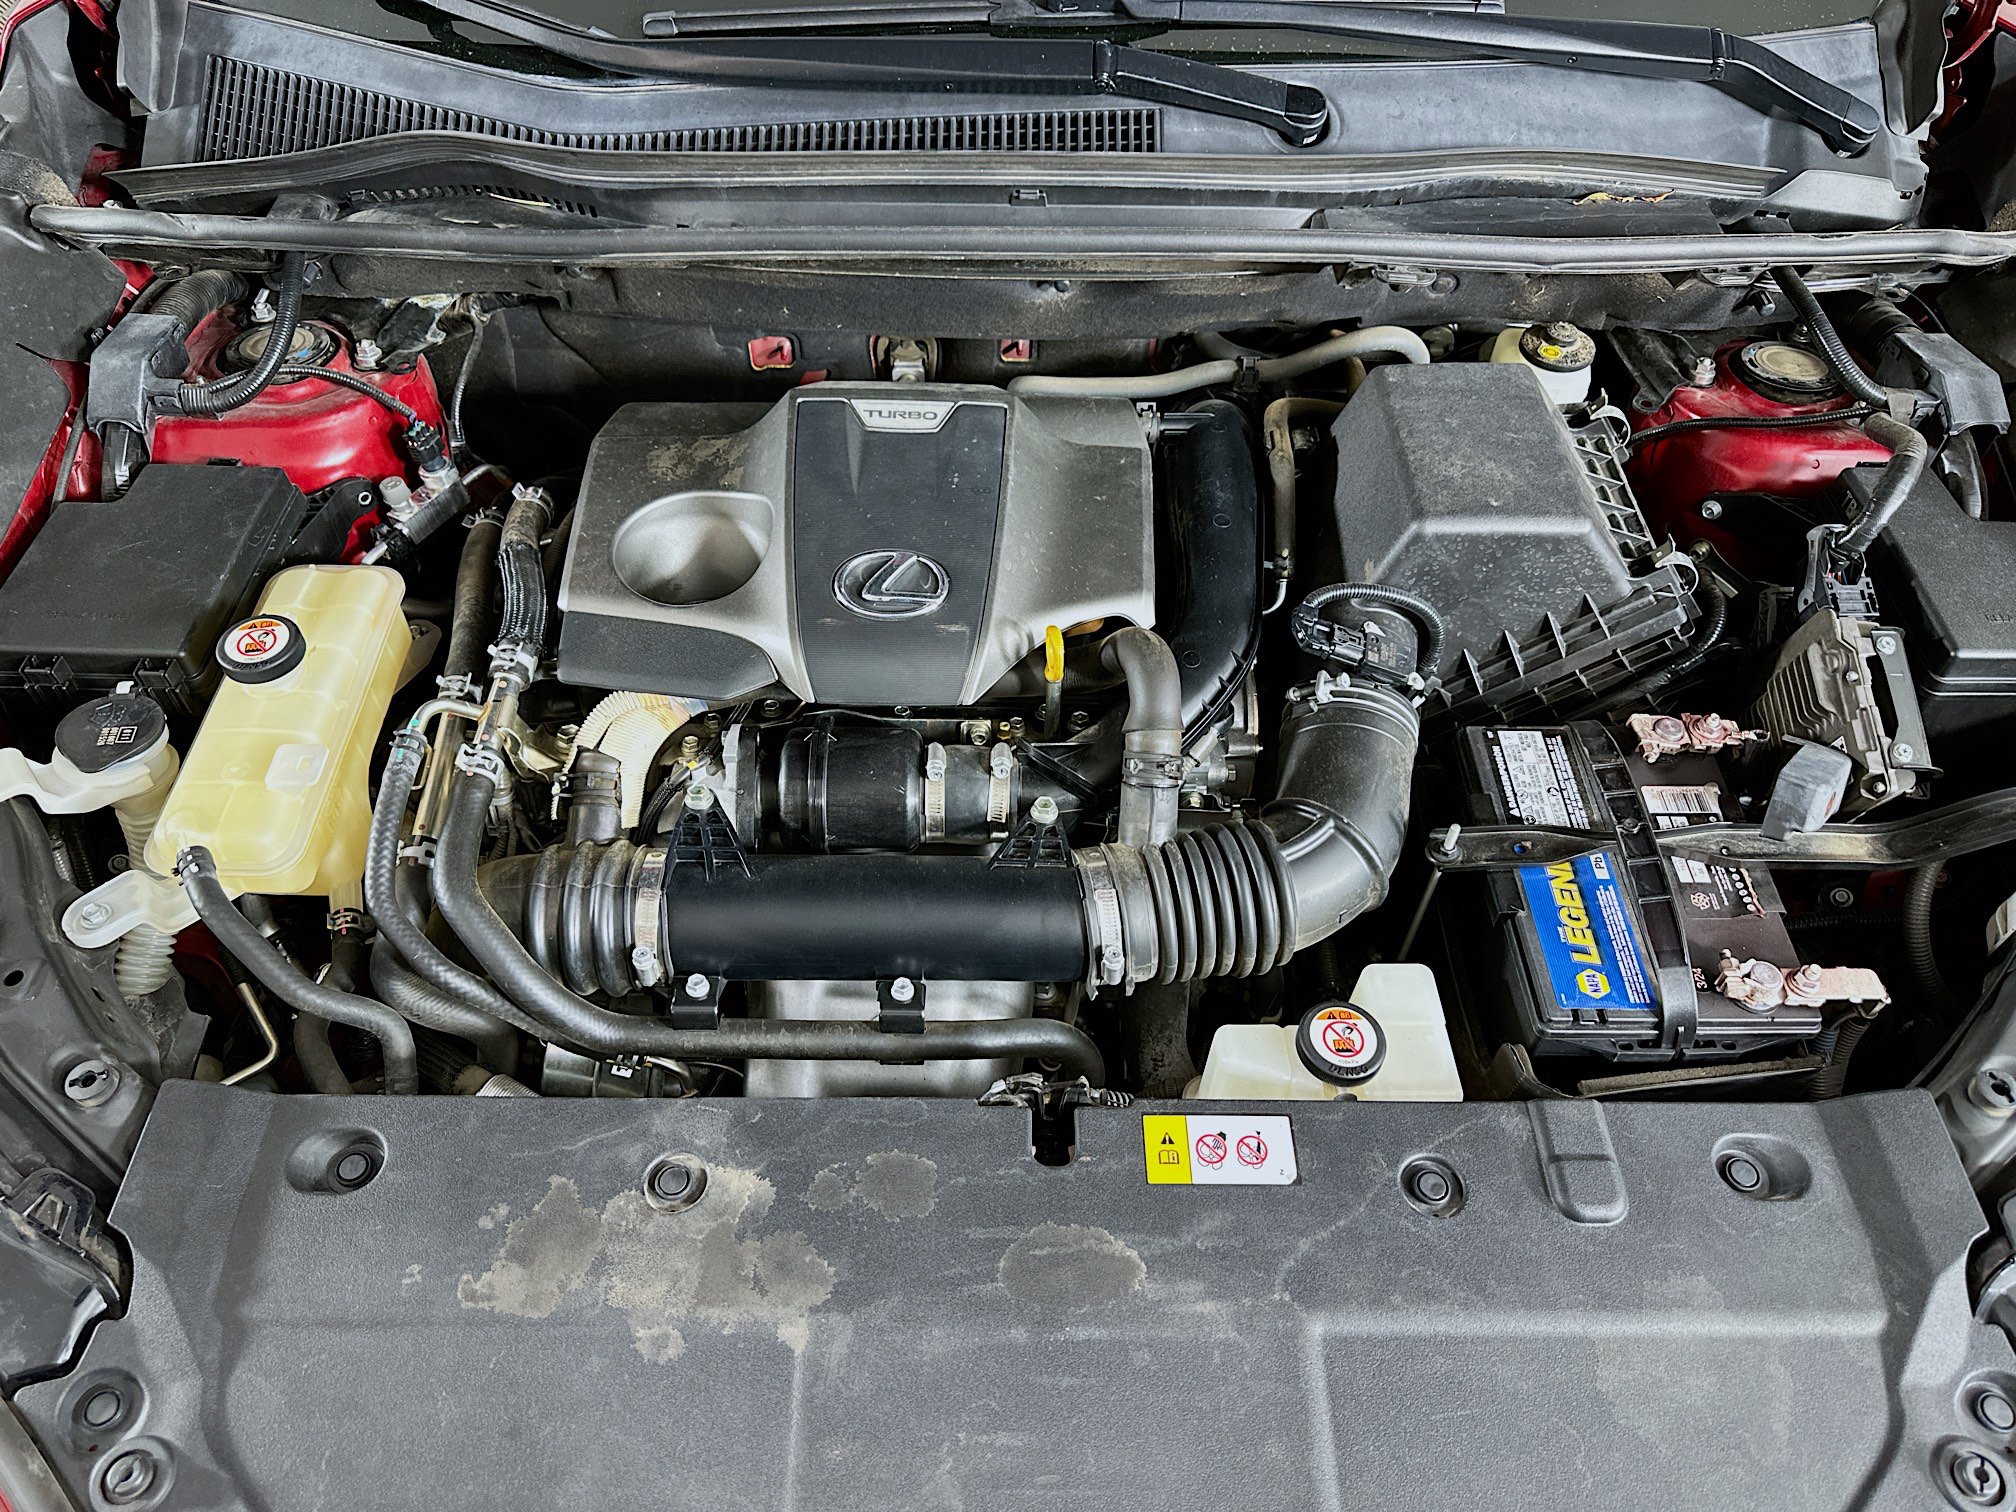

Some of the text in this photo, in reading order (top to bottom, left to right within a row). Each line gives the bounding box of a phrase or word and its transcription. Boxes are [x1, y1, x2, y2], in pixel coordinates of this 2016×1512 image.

[863, 409, 938, 420] TURBO
[1594, 856, 1603, 870] Pb
[1585, 973, 1602, 993] NAPA
[1692, 967, 1708, 989] 3/24
